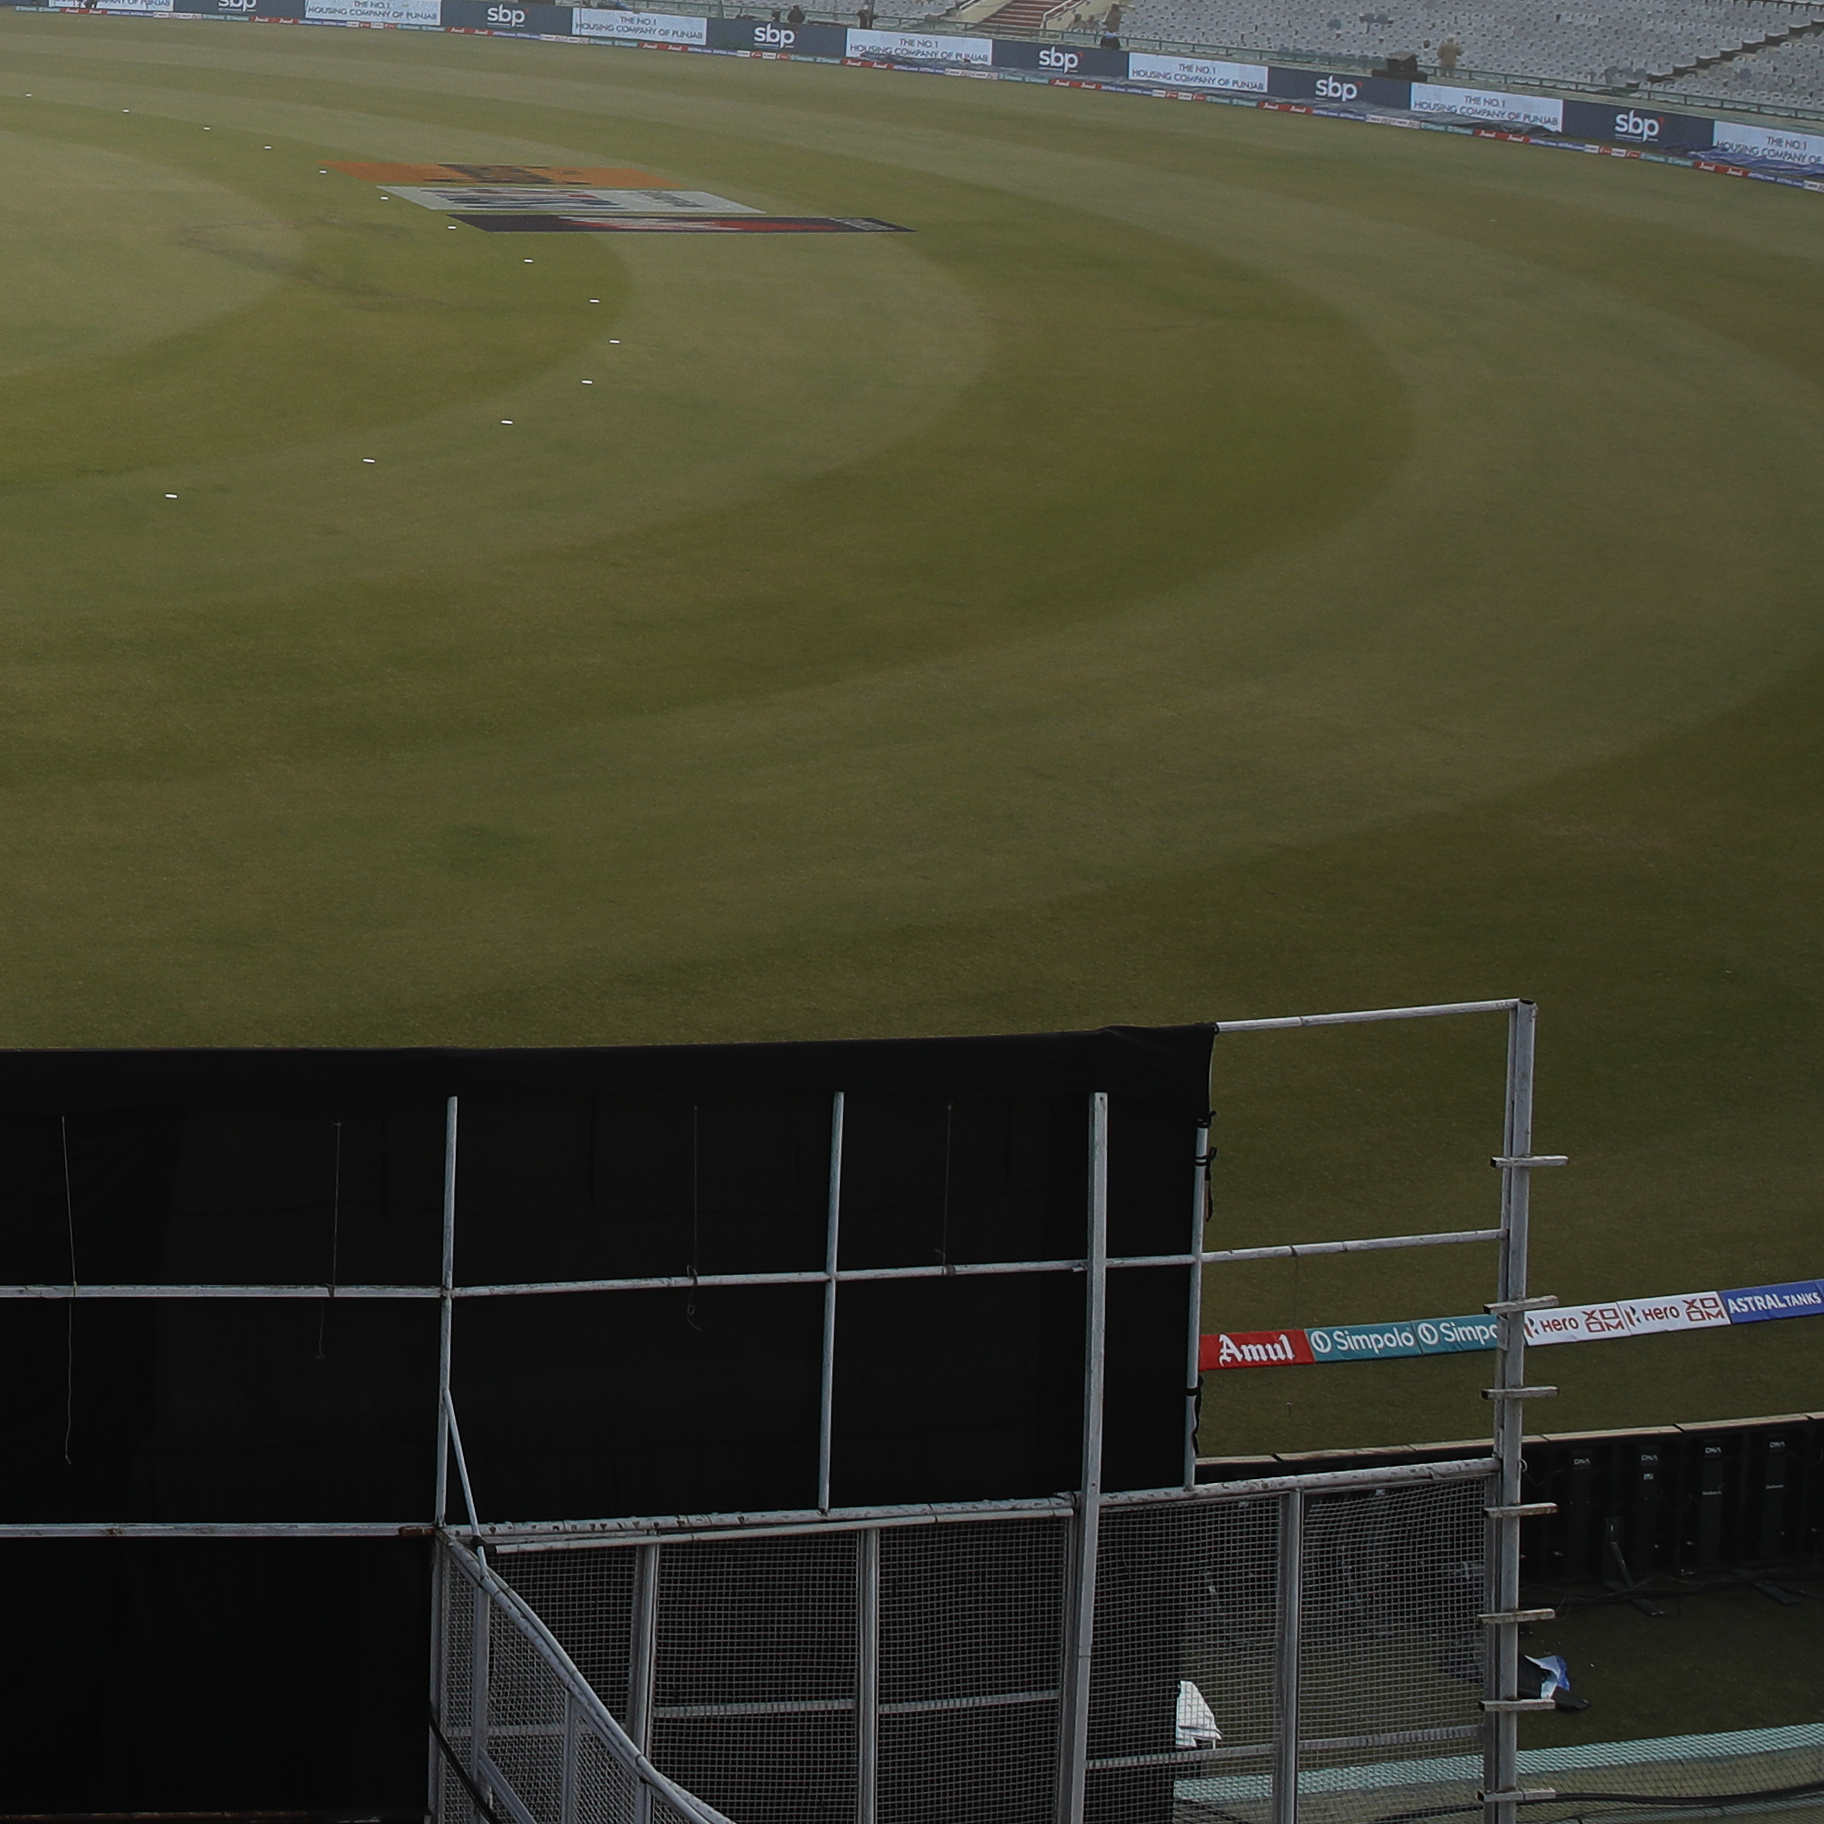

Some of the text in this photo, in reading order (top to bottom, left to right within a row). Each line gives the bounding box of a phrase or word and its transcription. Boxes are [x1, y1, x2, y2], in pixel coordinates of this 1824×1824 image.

[754, 24, 796, 48] sbp
[1316, 76, 1358, 102] sbp
[1728, 1291, 1821, 1315] ASTRAL TANKS
[1541, 1316, 1579, 1333] Hero
[1218, 1334, 1295, 1366] Amul
[1333, 1328, 1414, 1356] Simpolo
